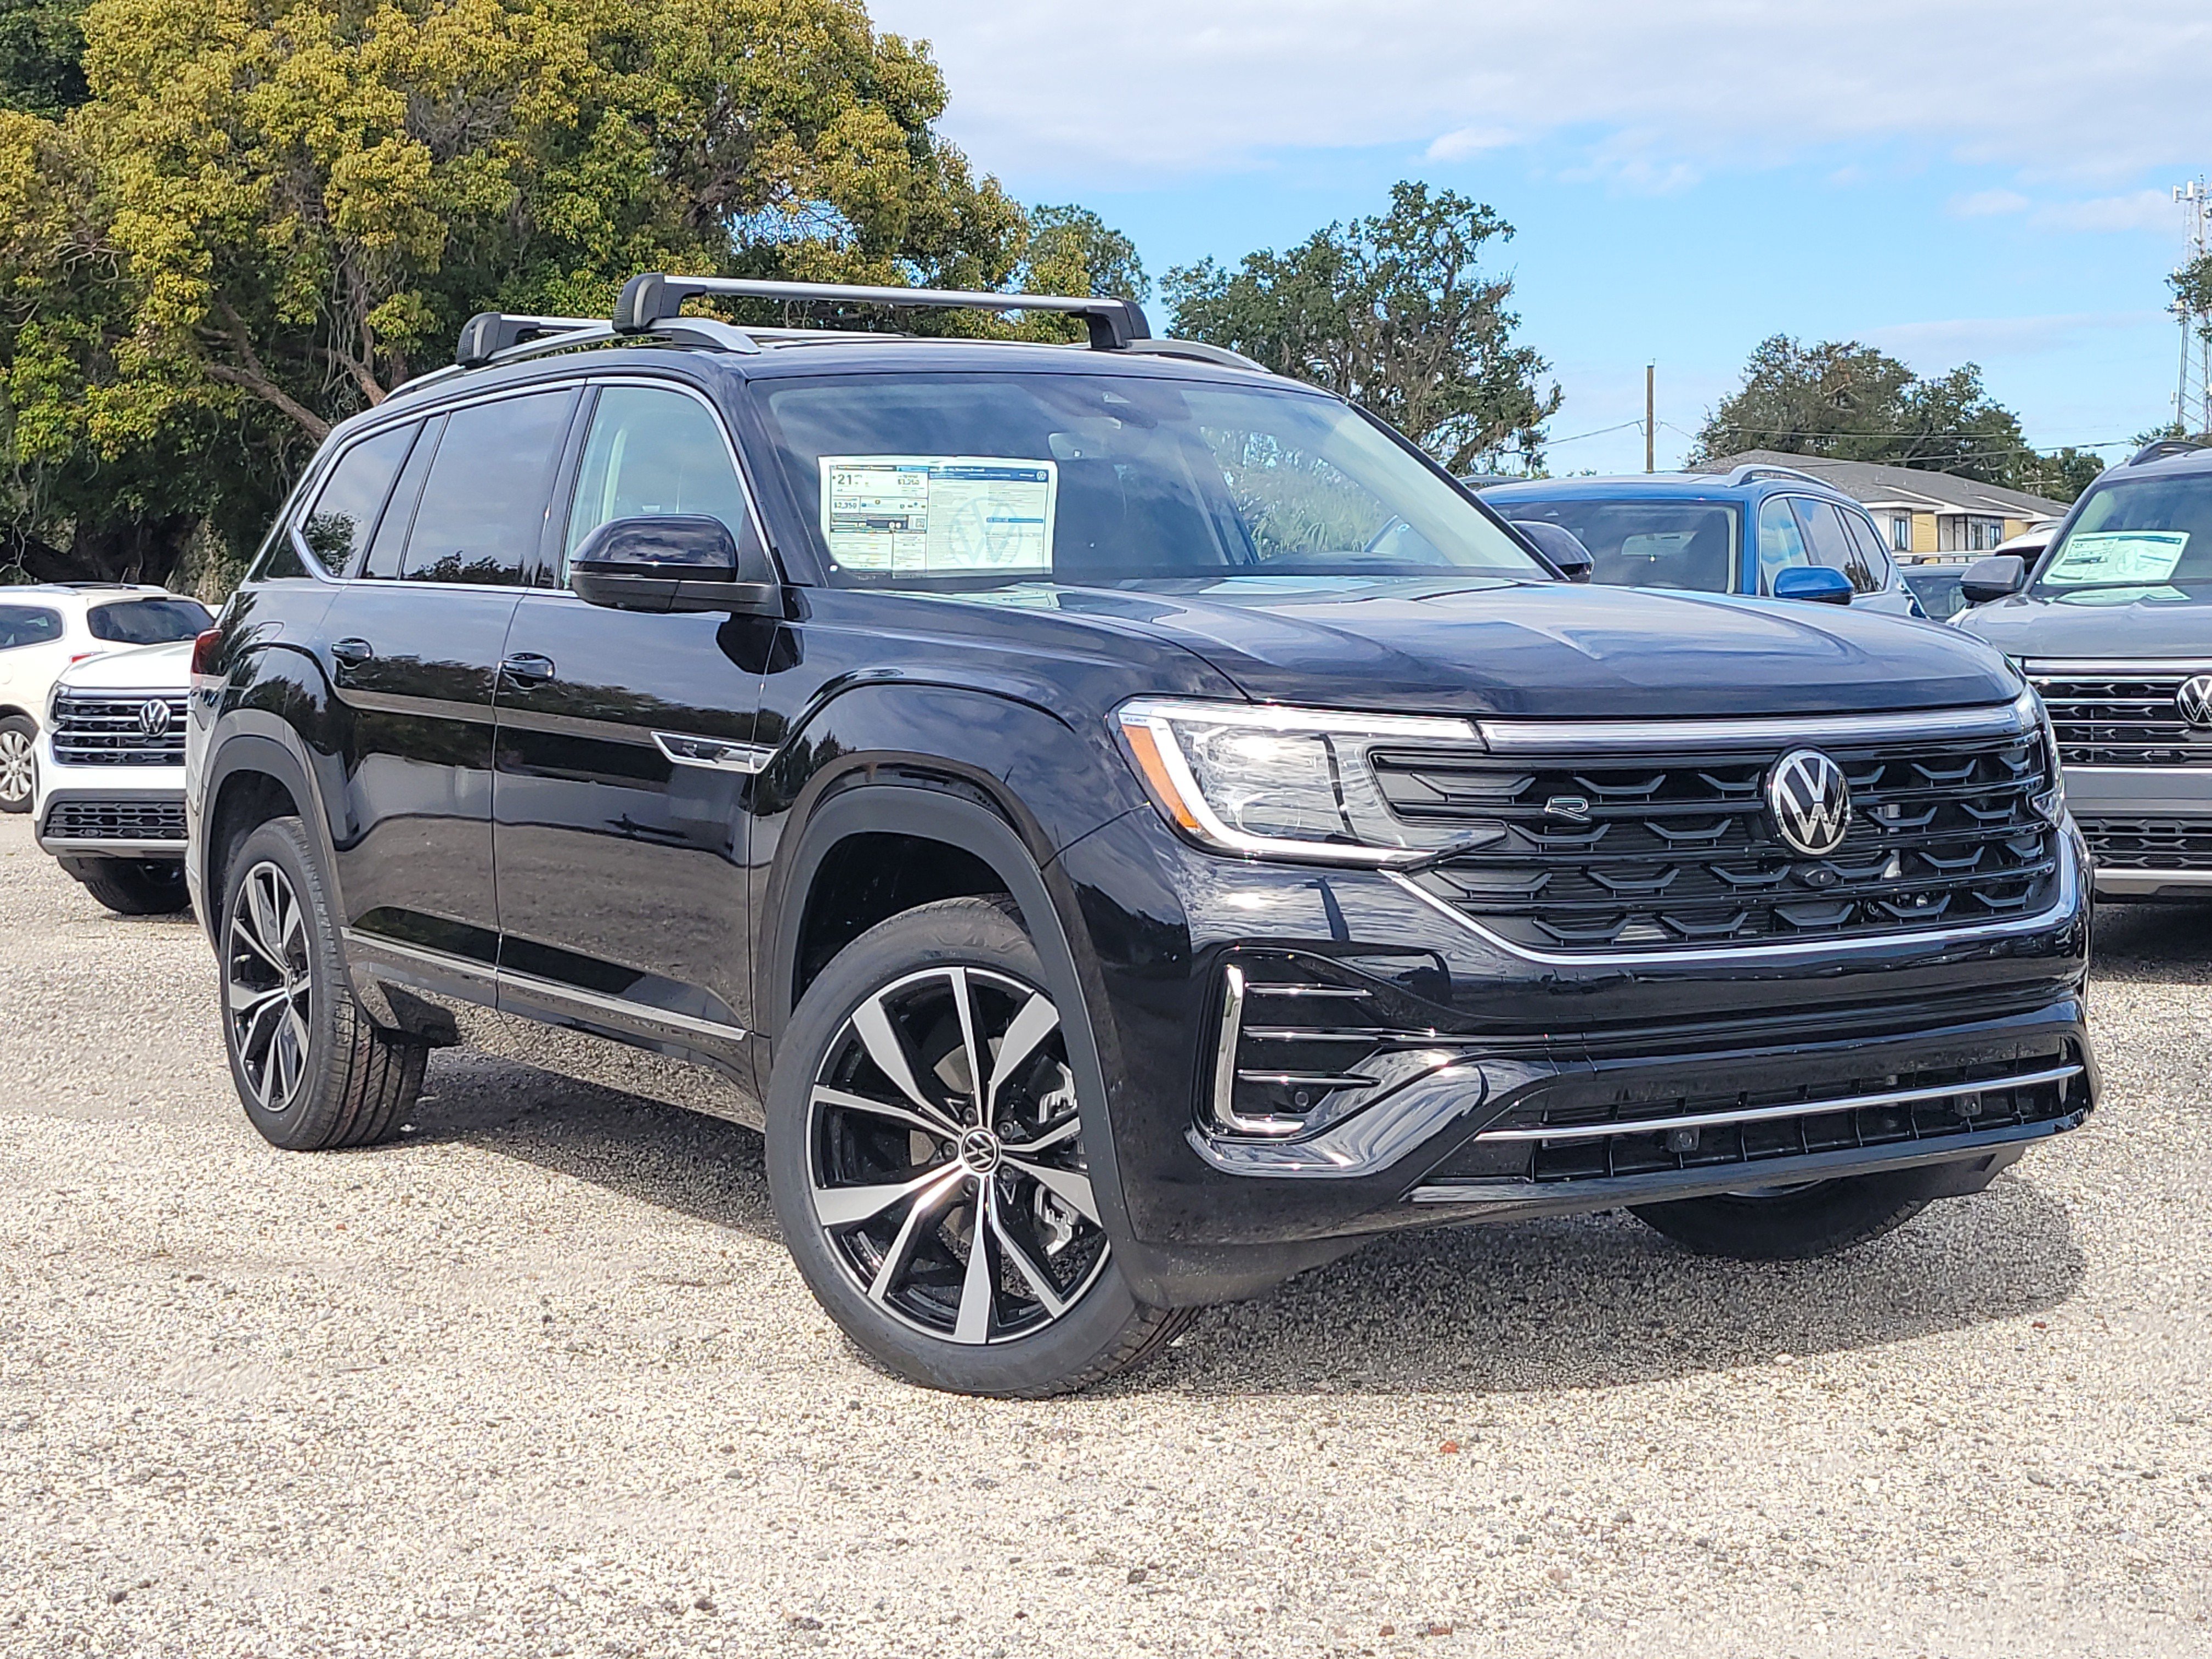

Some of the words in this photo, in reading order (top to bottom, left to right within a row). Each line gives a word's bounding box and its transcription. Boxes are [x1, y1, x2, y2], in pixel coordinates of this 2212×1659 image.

[837, 473, 851, 485] 21
[139, 699, 170, 737] VW
[1544, 795, 1592, 823] R
[1769, 749, 1850, 855] VW
[962, 1130, 997, 1171] VW
